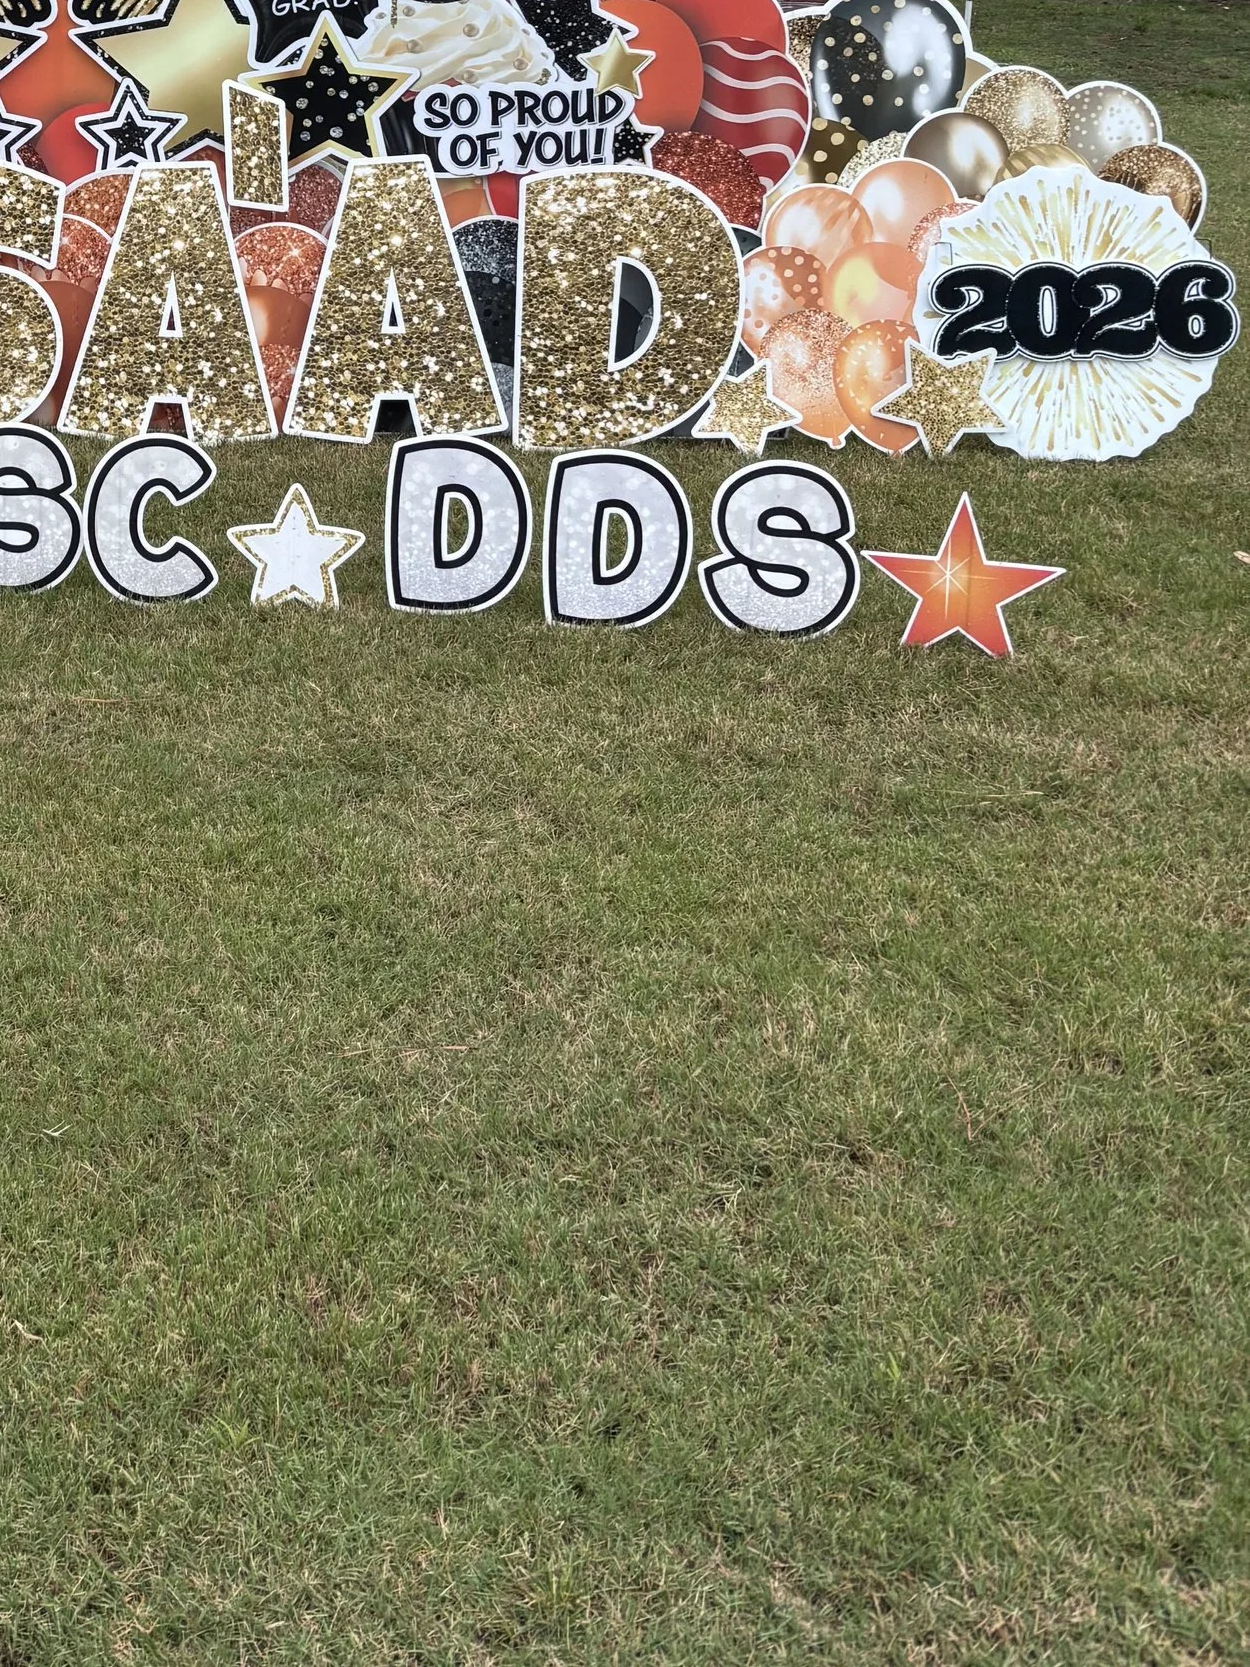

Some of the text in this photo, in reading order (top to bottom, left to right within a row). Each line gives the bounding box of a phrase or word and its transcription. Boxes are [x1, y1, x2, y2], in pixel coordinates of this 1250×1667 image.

[423, 87, 625, 130] SO PROUD
[449, 127, 607, 169] OF YOU!
[926, 260, 1239, 363] 2026
[385, 434, 861, 641] DDS
